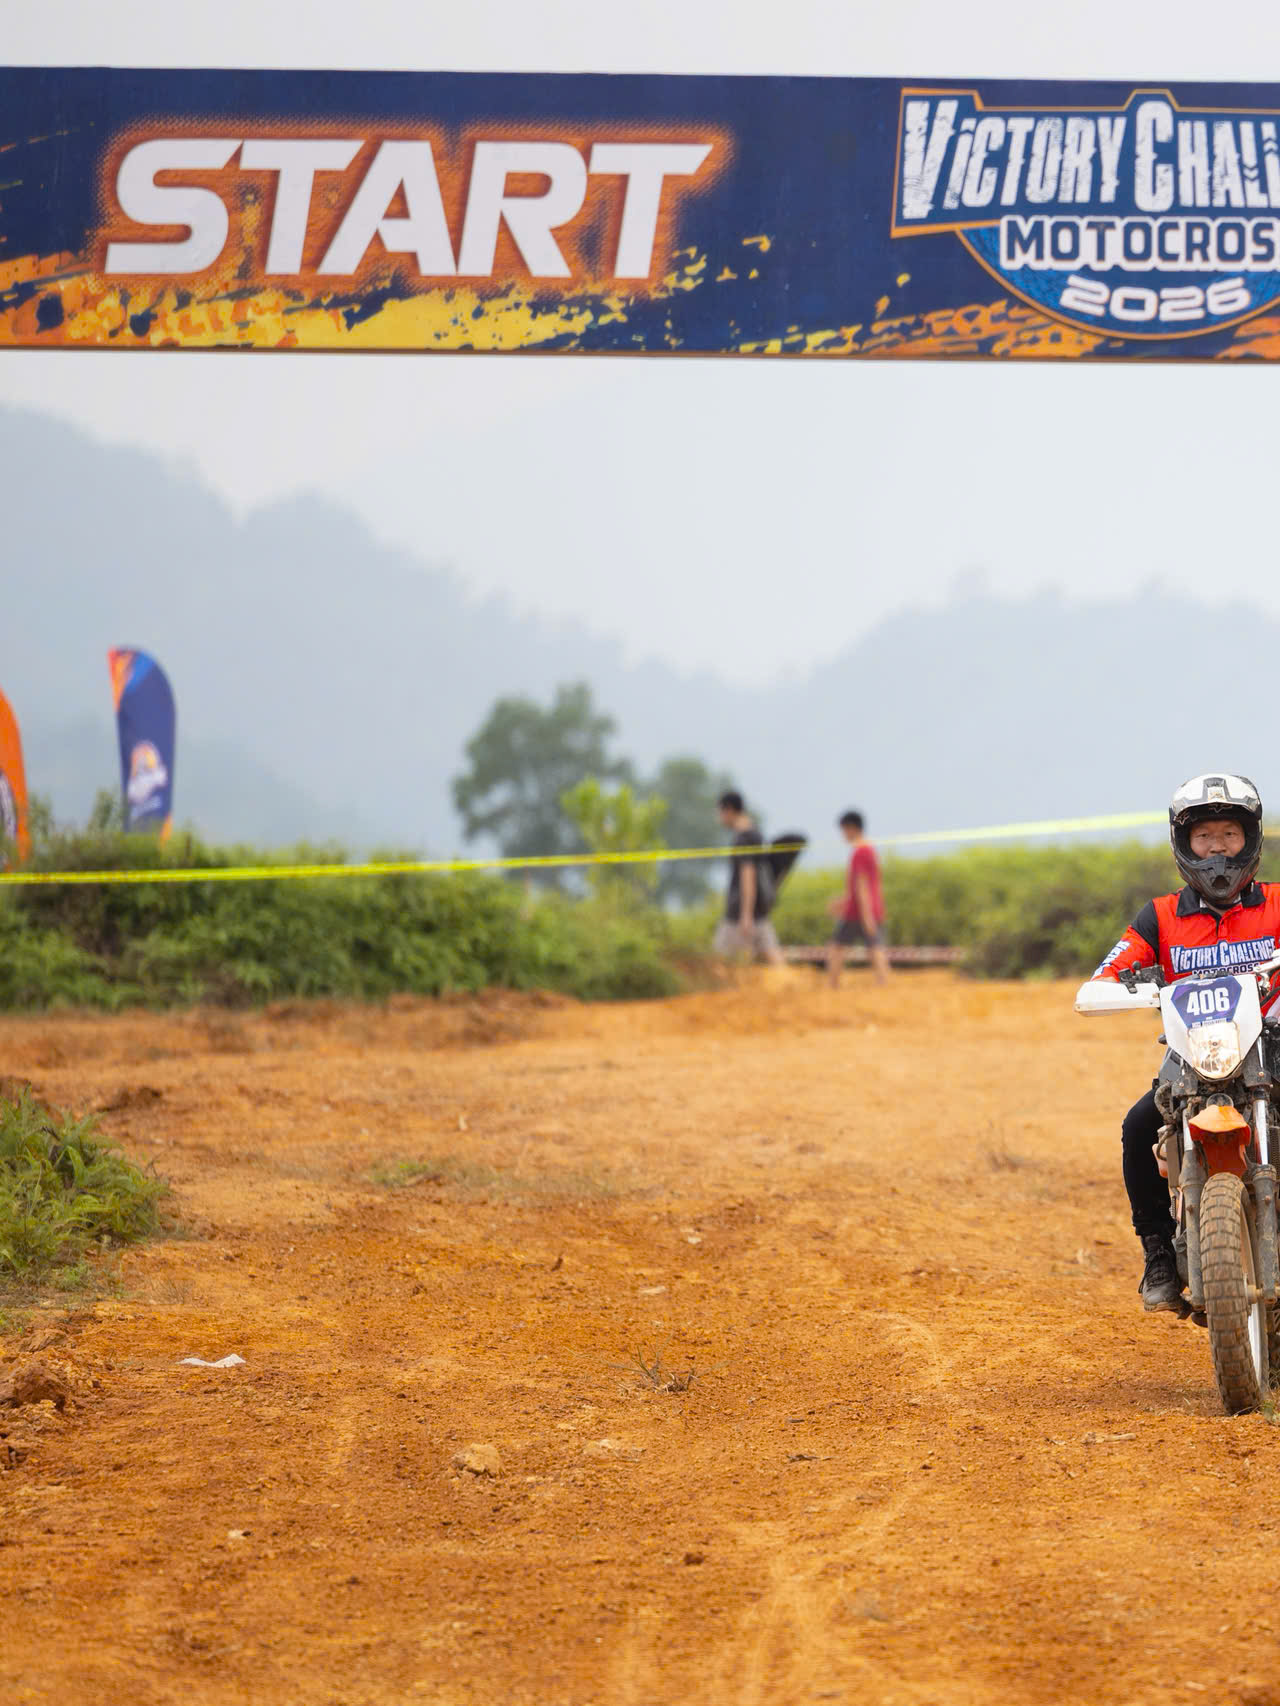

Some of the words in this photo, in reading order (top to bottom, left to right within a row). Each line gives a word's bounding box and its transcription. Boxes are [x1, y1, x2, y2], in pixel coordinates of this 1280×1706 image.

[902, 100, 1127, 219] VICTORY
[105, 138, 713, 279] START
[1059, 274, 1251, 322] 2026
[1170, 946, 1219, 974] VICTORY
[1186, 987, 1231, 1016] 406
